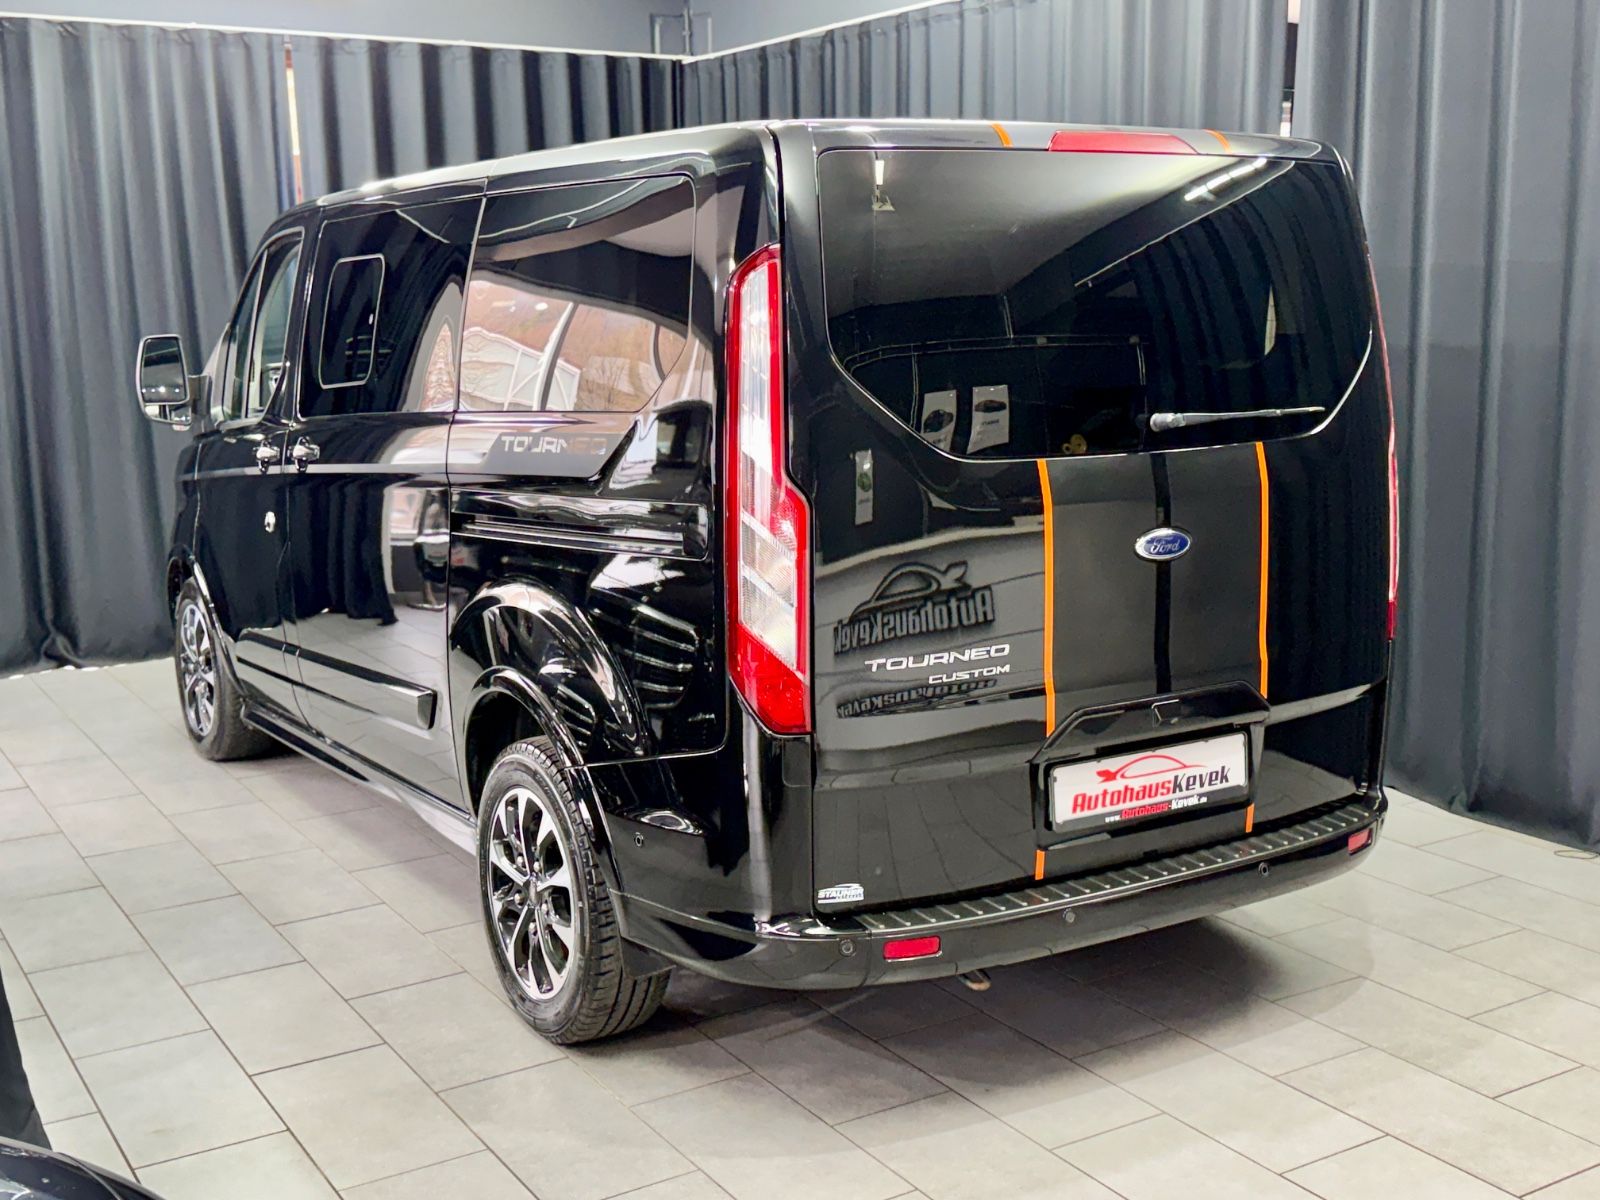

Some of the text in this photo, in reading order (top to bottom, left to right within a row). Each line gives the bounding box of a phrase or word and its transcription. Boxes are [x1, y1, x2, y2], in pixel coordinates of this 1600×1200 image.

[1150, 536, 1180, 553] Ford
[864, 643, 1010, 672] TOURNEO
[928, 664, 1010, 684] CUSTOM
[1072, 765, 1230, 814] AutohausKevek
